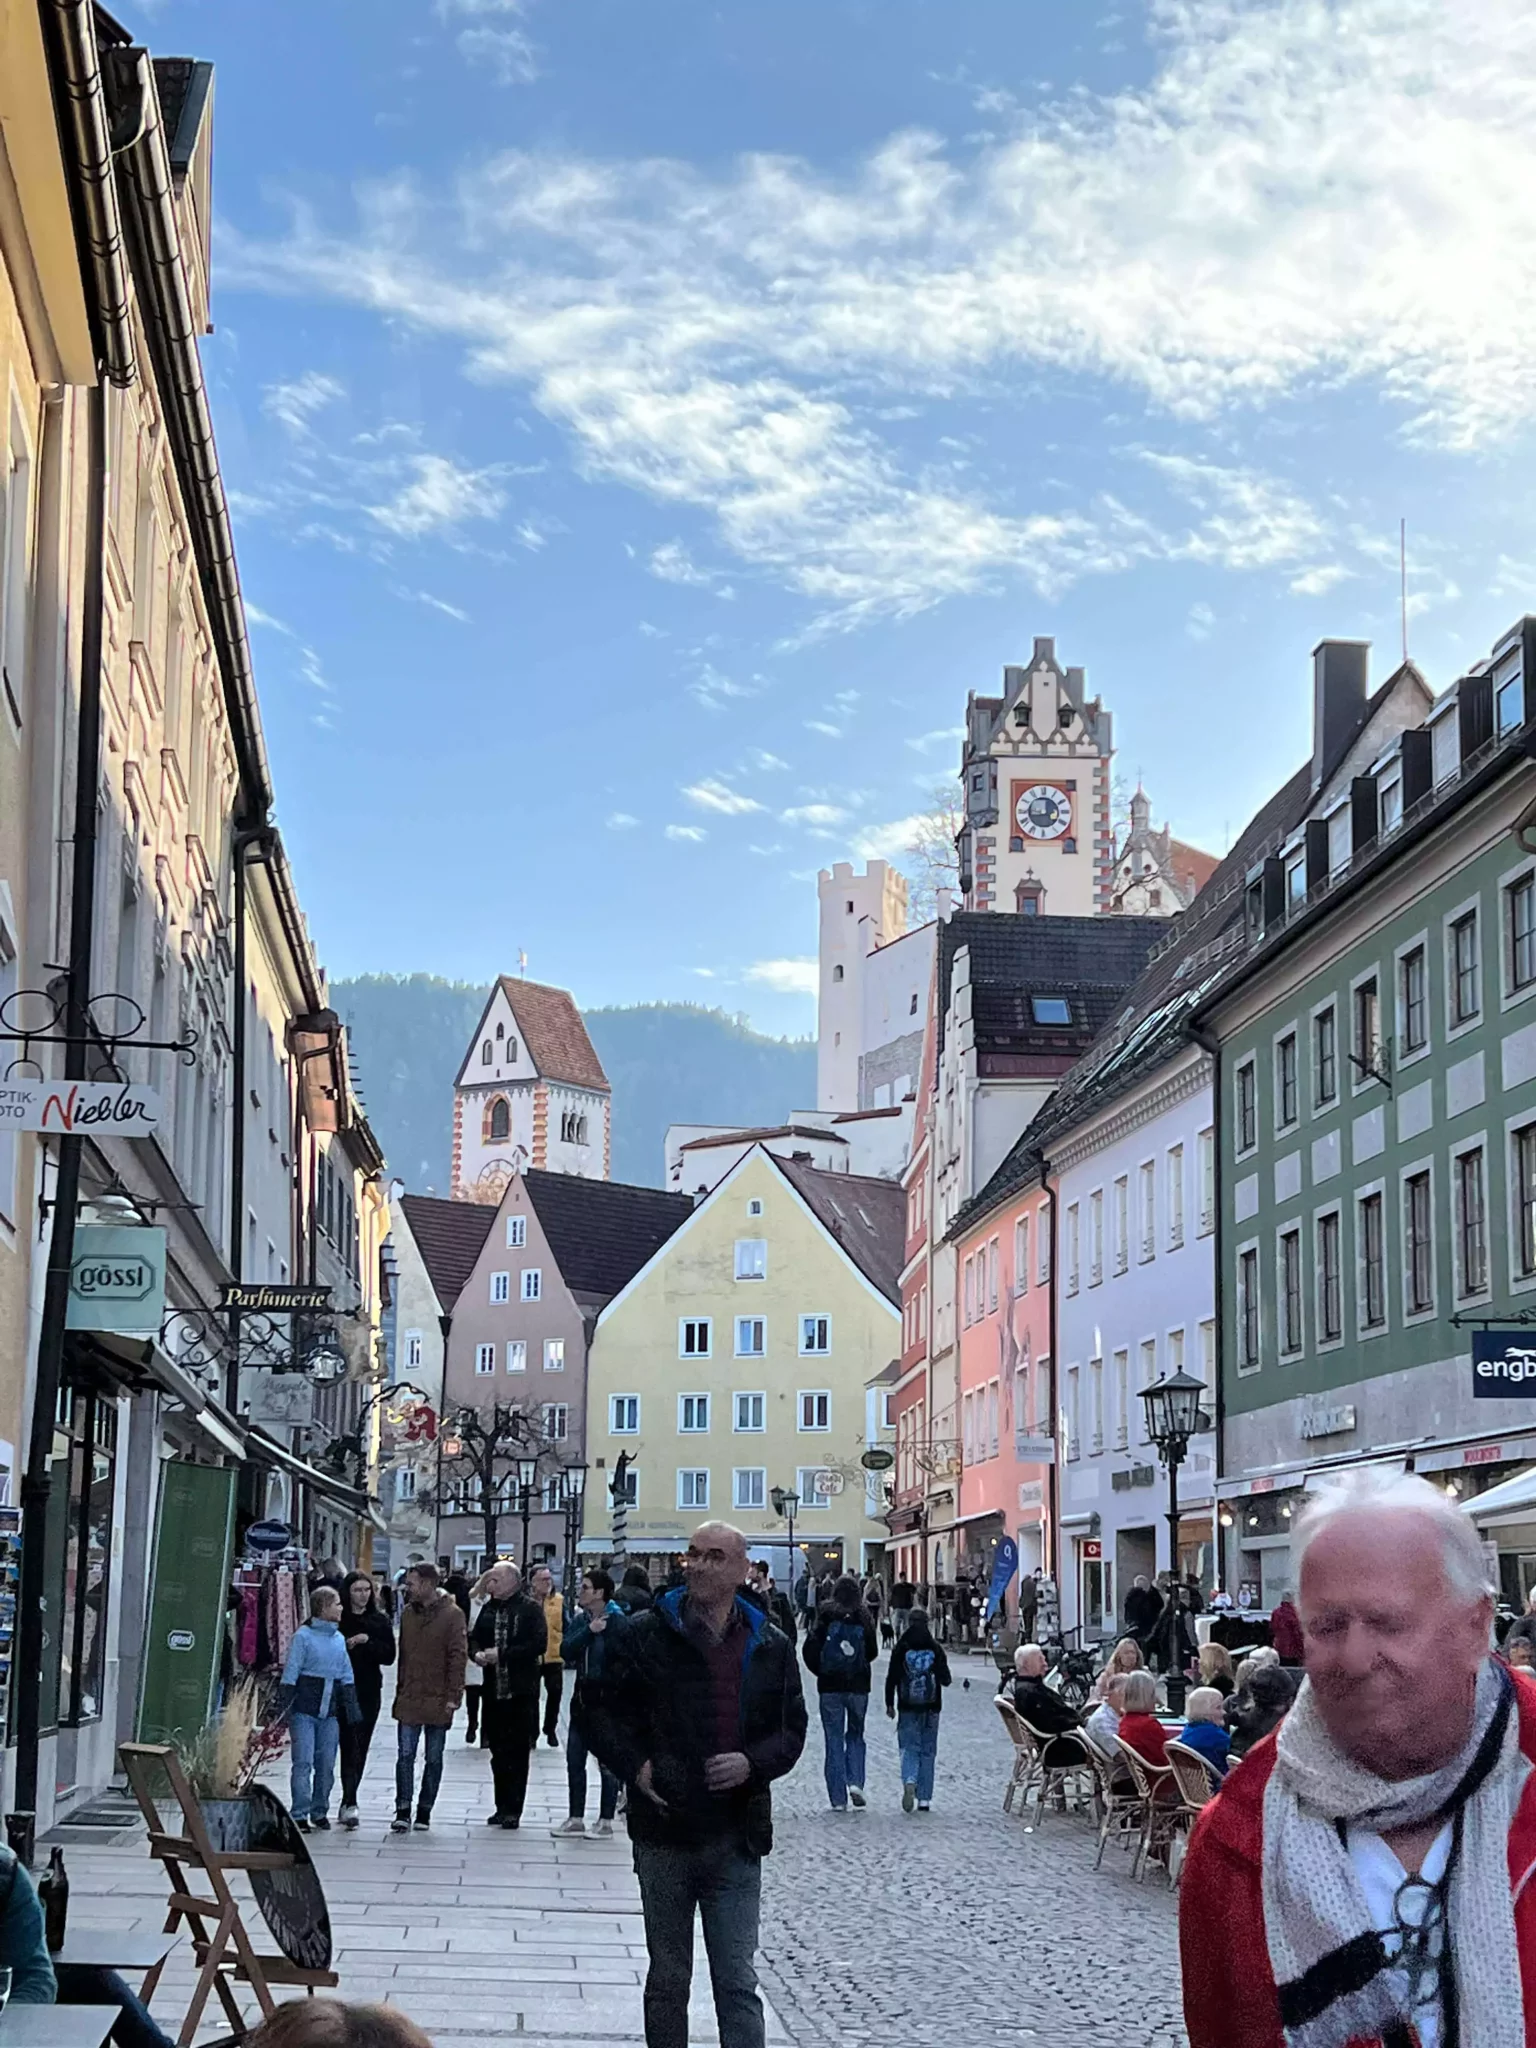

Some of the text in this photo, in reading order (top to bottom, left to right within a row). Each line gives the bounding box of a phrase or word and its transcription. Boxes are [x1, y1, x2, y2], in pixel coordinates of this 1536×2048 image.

[41, 1085, 157, 1131] Niebler
[80, 1264, 143, 1292] gössl
[225, 1286, 325, 1308] Parfümerie
[1477, 1356, 1536, 1382] engb
